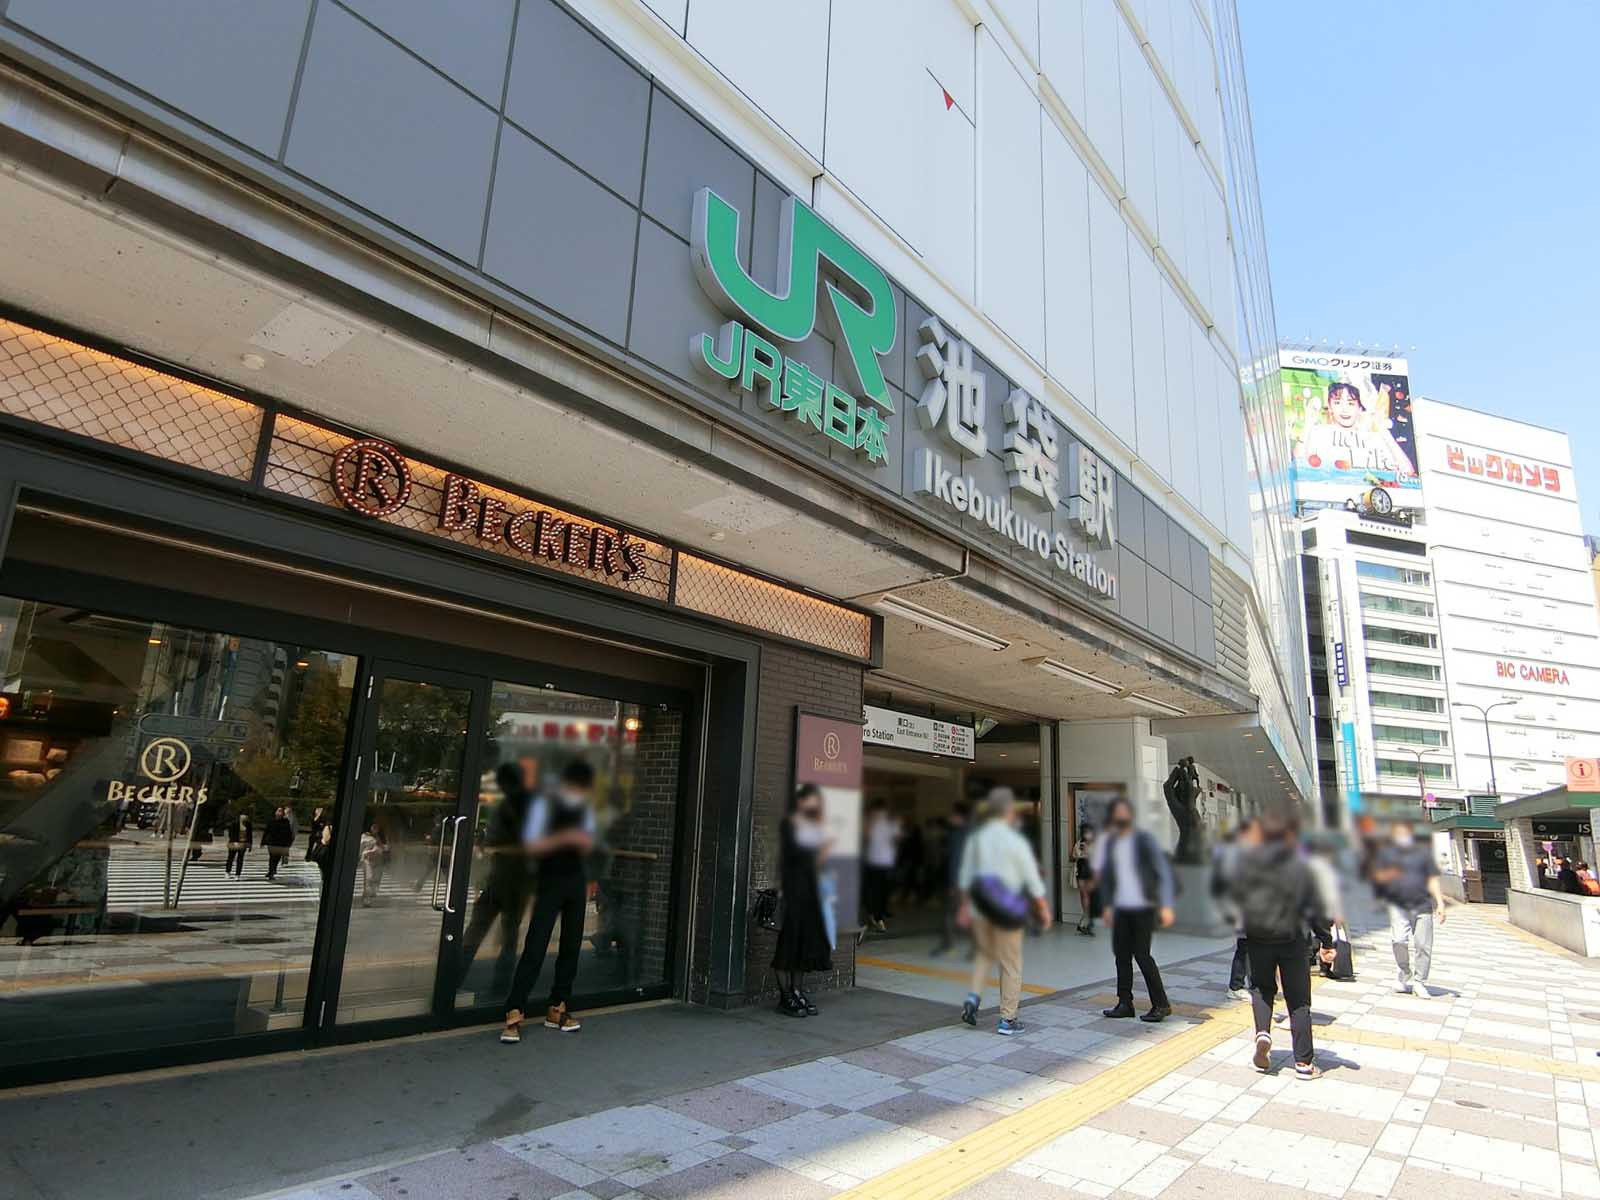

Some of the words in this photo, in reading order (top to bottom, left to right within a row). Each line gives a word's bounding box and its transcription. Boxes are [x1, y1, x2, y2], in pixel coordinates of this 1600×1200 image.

[694, 186, 897, 415] JR
[693, 320, 889, 466] JR東日本
[1292, 354, 1393, 371] GMOクリック証券
[914, 316, 1117, 551] 池袋駅
[1445, 444, 1561, 492] ビックカメラ
[916, 447, 1051, 560] Ikebukuro
[1055, 531, 1118, 600] Station
[1496, 660, 1516, 680] BIC
[1519, 664, 1570, 686] CAMERA
[872, 728, 894, 744] Station
